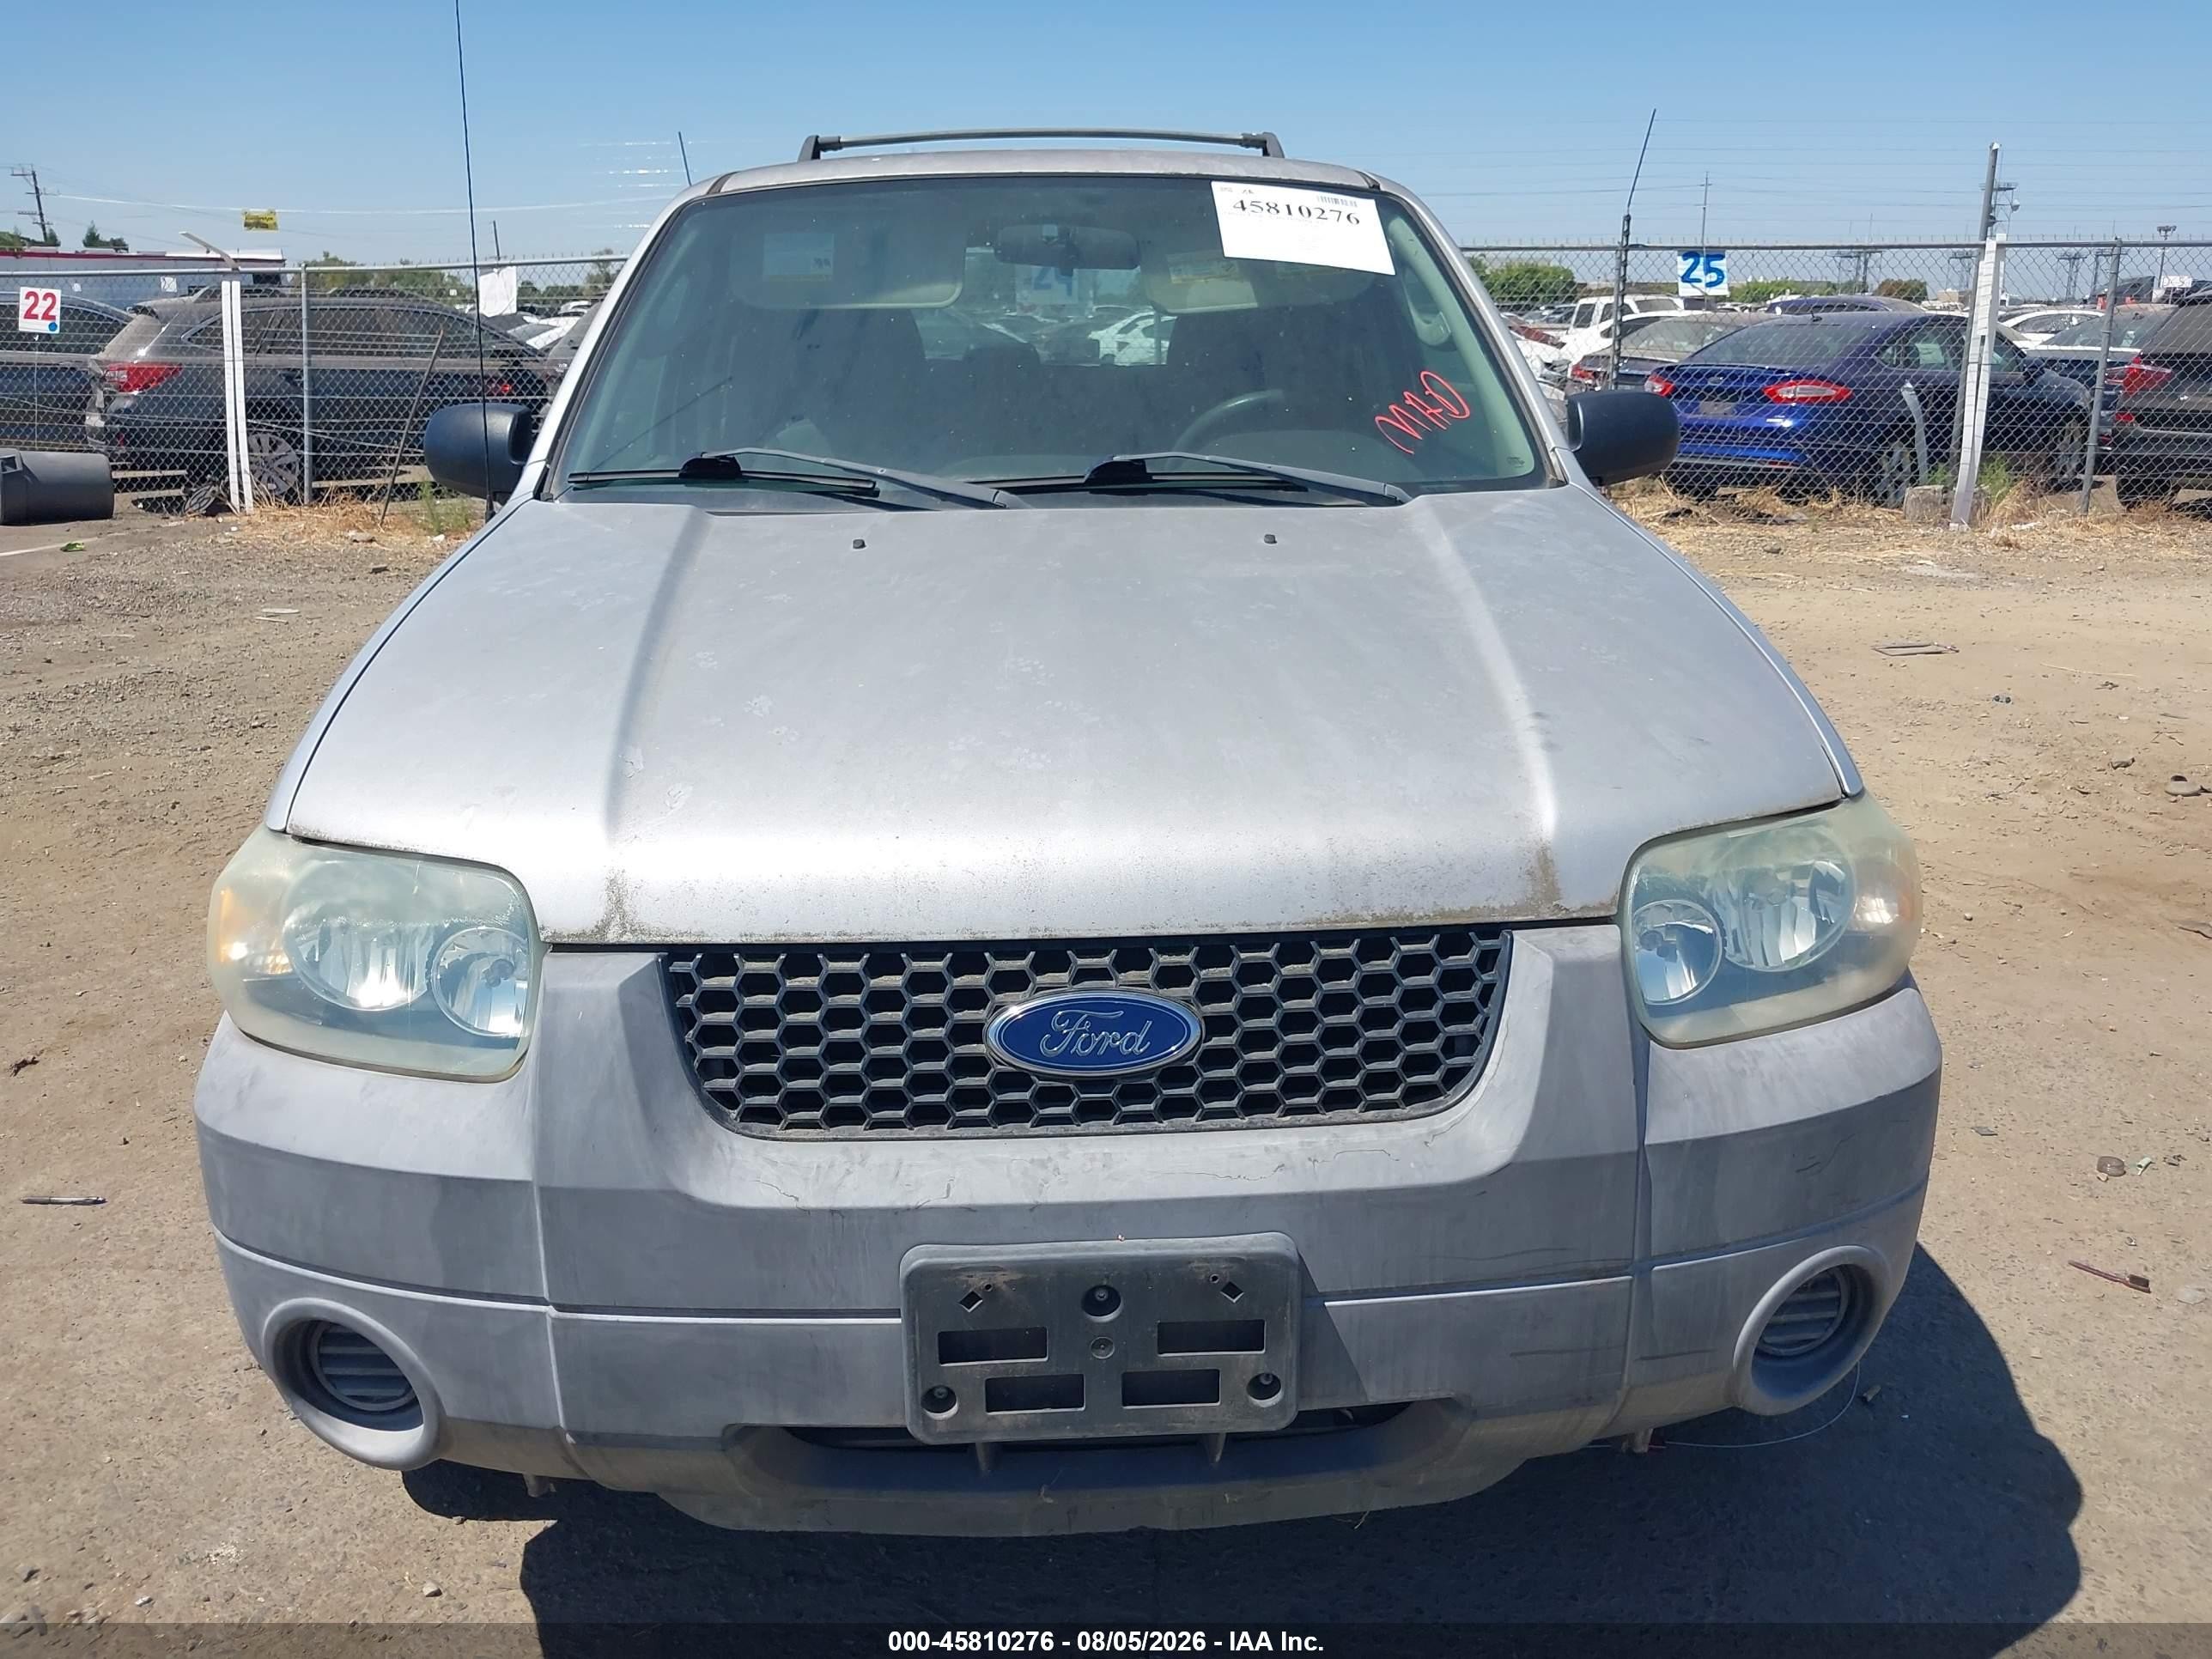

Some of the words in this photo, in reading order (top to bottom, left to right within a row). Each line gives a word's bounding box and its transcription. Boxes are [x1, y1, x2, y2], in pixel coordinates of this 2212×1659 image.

[1233, 198, 1360, 226] 45810276
[1680, 251, 1726, 288] 25
[23, 290, 57, 320] 22
[1039, 1008, 1153, 1058] Ford
